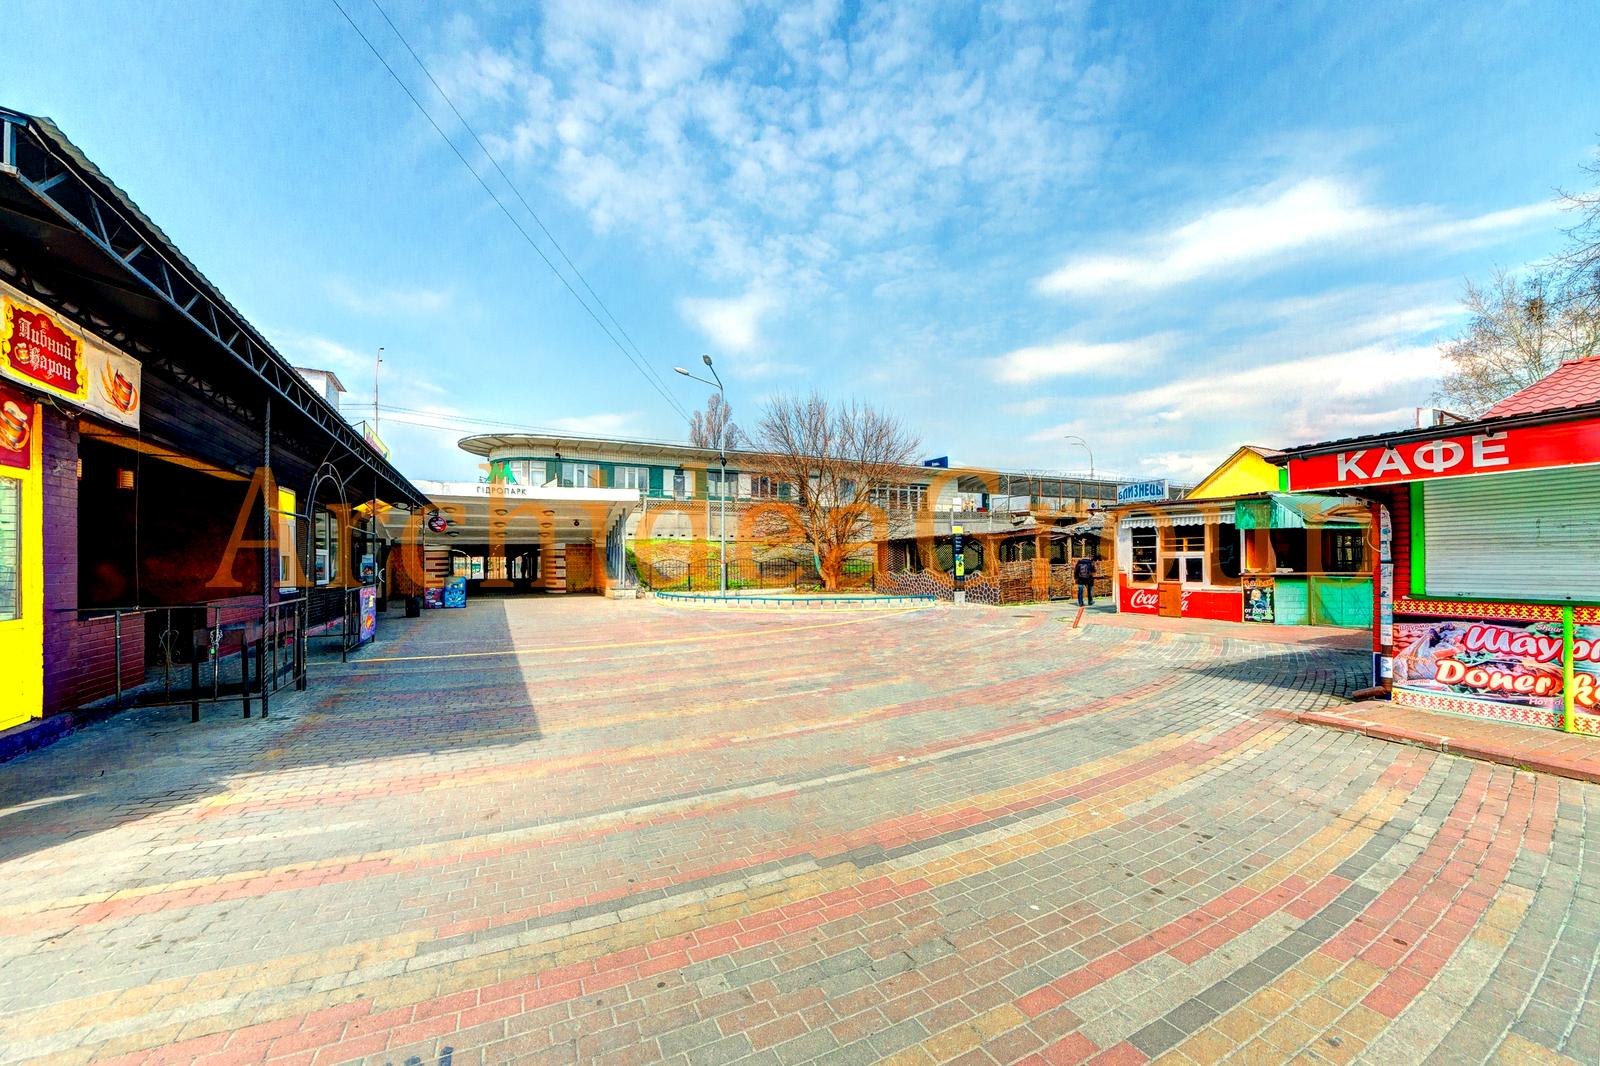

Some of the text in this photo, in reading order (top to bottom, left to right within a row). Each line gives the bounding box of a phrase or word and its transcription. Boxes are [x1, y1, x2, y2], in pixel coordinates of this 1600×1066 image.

[1337, 431, 1510, 482] КАФЕ
[476, 486, 527, 495] ГІДРОПАРК
[1118, 483, 1164, 500] БЛИЗНЕЦЫ
[1438, 660, 1553, 694] Doner
